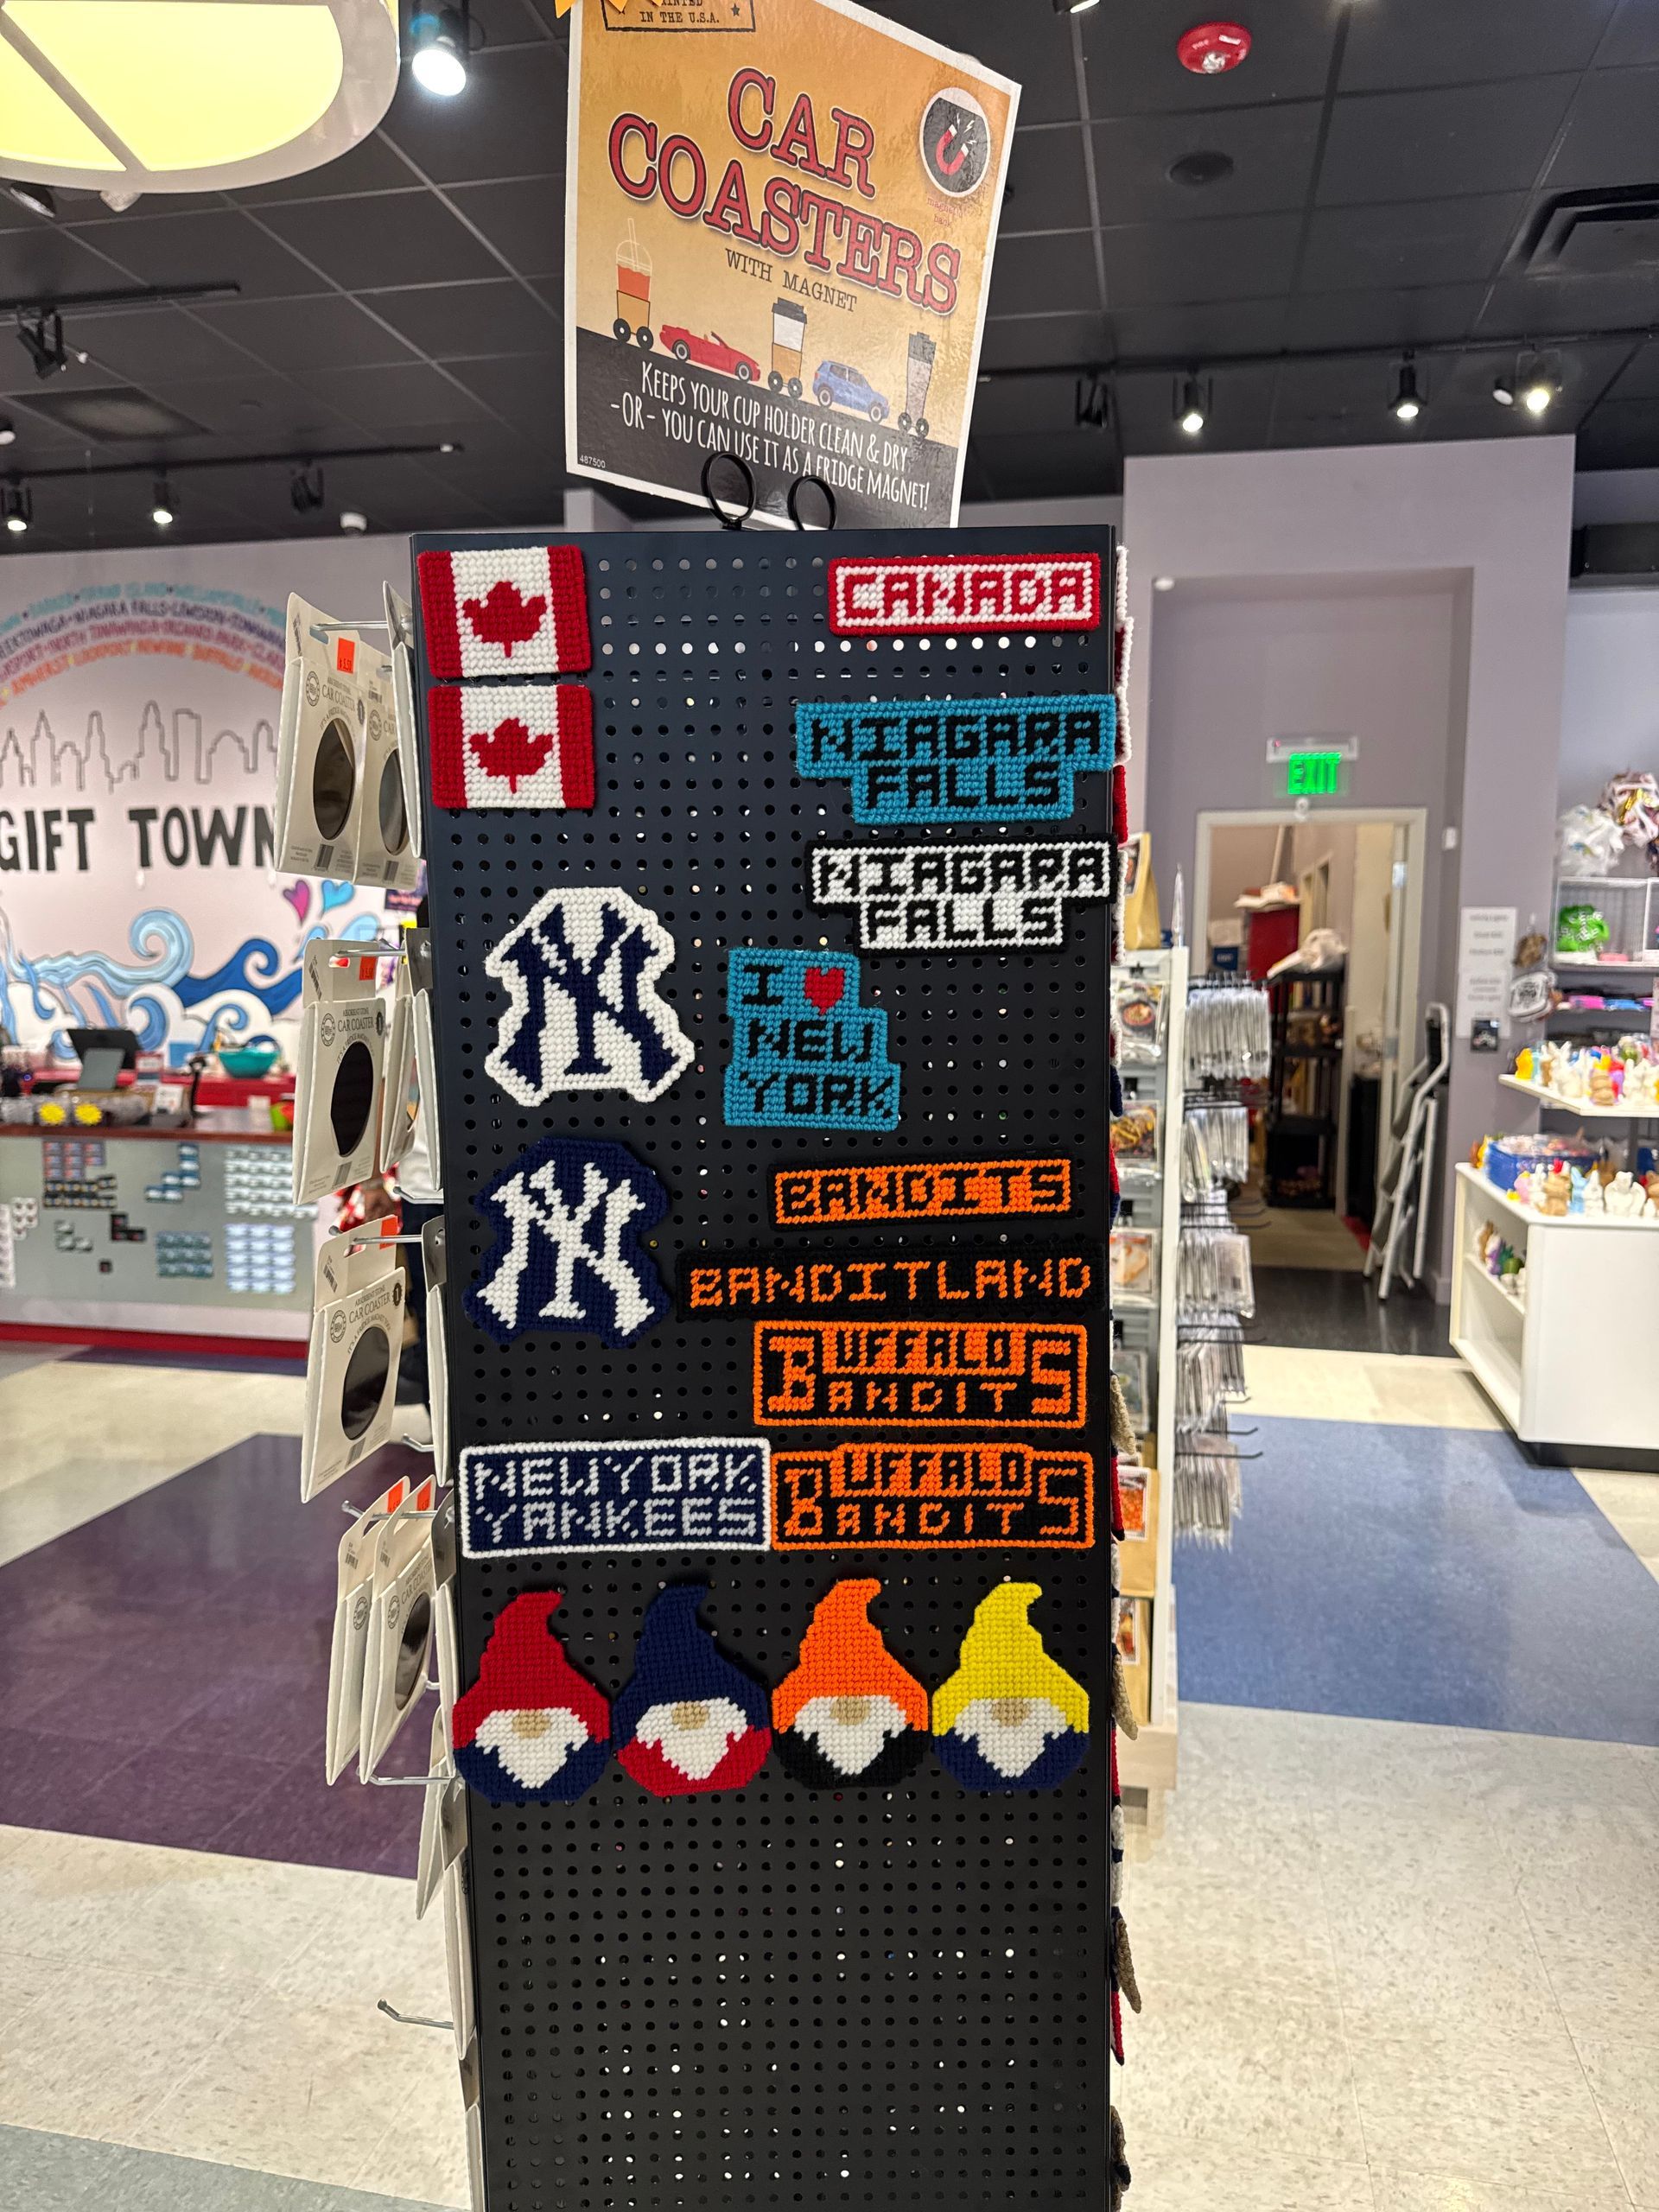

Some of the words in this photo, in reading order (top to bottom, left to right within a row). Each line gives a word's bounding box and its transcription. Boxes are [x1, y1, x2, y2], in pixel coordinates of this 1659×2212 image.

[639, 11, 653, 22] IN
[659, 12, 683, 23] THE
[689, 12, 720, 23] U.S.A.
[728, 67, 875, 198] CAR
[608, 112, 961, 315] COASTERS
[725, 248, 773, 283] WITH
[782, 270, 857, 313] MAGNET
[690, 380, 729, 421] YOUR
[734, 395, 760, 429] CUP
[765, 404, 816, 447] HOLDER
[819, 422, 864, 459] CLEAN
[866, 433, 880, 464] &
[883, 441, 908, 473] DRY
[579, 454, 606, 468] 487500
[662, 408, 694, 444] YOU
[697, 419, 730, 452] CAN
[734, 429, 760, 464] USE
[764, 439, 779, 468] IT
[783, 445, 799, 474] AS
[803, 451, 811, 477] A
[816, 454, 865, 493] FRIDGE
[867, 469, 931, 511] MAGNET!
[843, 569, 1087, 618] CANADA
[810, 710, 1101, 763] NIAGARA
[867, 760, 1061, 809] FALLS
[0, 808, 95, 872] GIFT
[819, 847, 1105, 897] NIAGARA
[866, 897, 1063, 943] FALLS
[743, 964, 784, 1006] I
[338, 1019, 350, 1033] CAR
[352, 1016, 374, 1031] COASTER
[748, 1019, 873, 1063] NEW
[741, 1071, 896, 1121] YORK
[779, 1165, 1067, 1214] BANDITS
[690, 1257, 1091, 1309] BANDITLAND
[349, 1306, 364, 1324] CAR
[364, 1292, 391, 1316] COASTER
[474, 1456, 599, 1501] NEW
[604, 1452, 757, 1496] YORK
[475, 1497, 757, 1544] YANKEES
